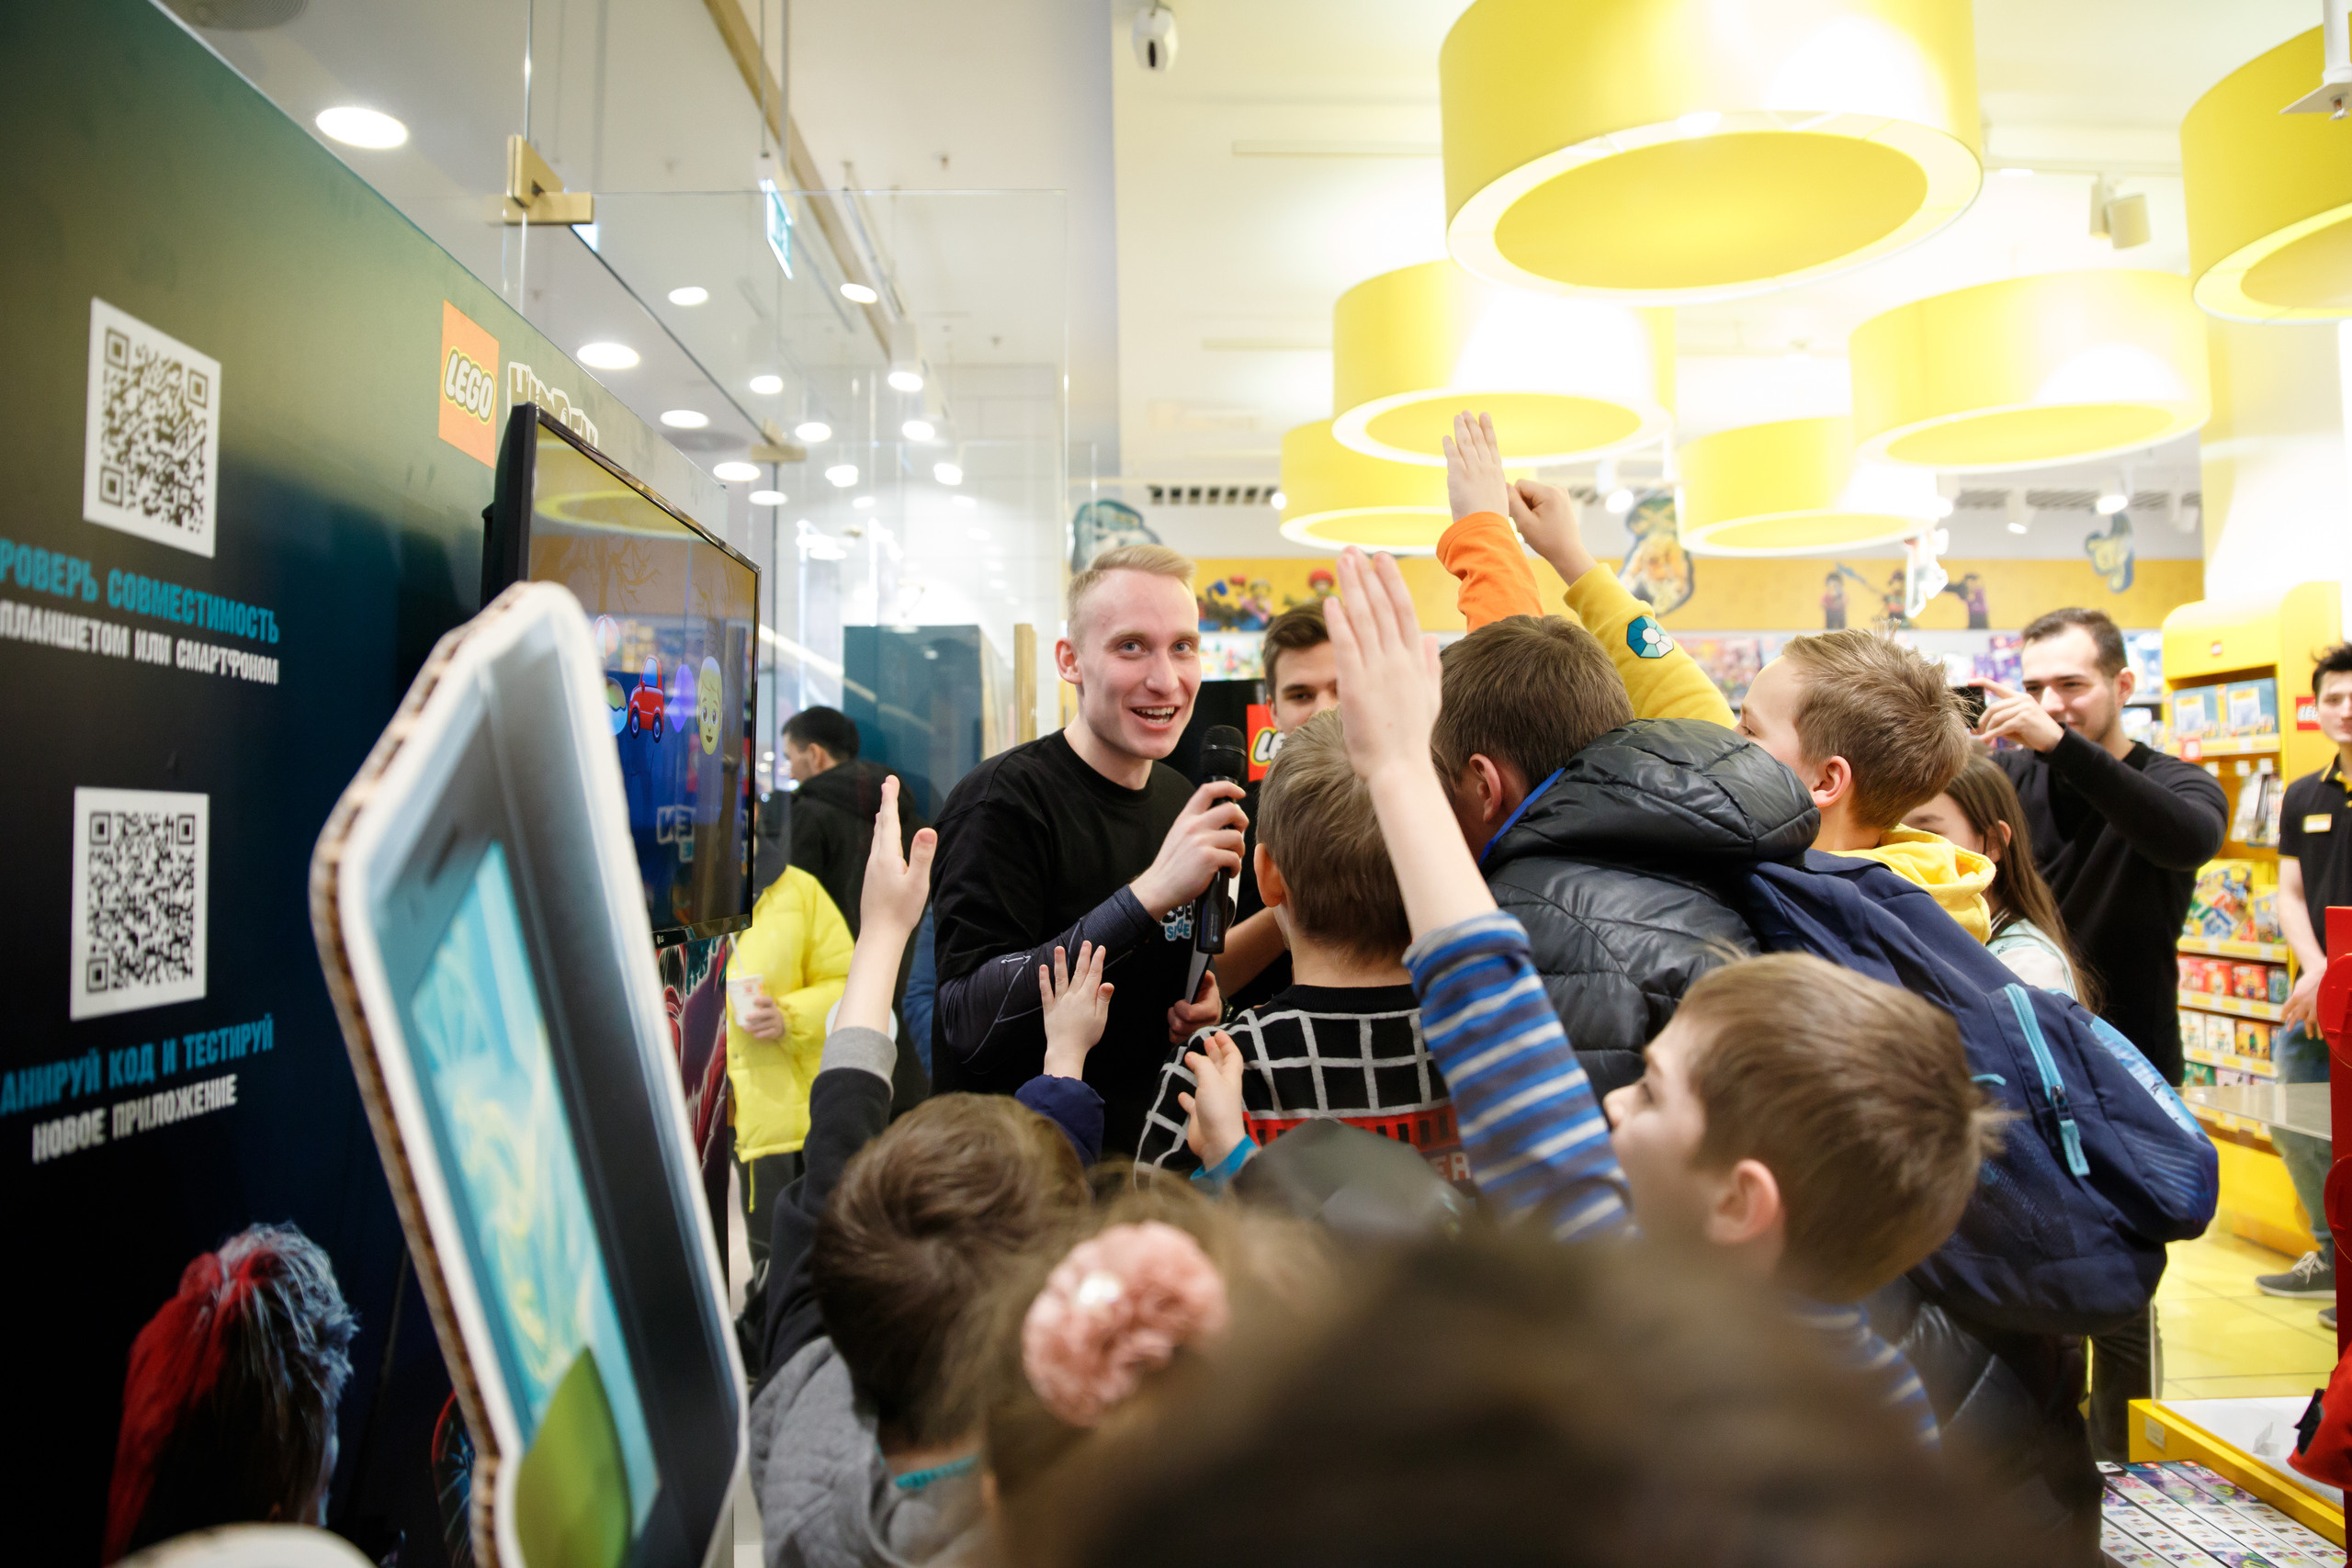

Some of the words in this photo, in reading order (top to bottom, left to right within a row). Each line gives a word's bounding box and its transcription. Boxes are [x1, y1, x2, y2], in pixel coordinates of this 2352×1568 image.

[444, 350, 495, 422] LEGO
[0, 600, 130, 659] ПЛАНШЕТОМ
[134, 628, 173, 667] ИЛИ
[175, 638, 279, 685] СМАРТФОНОМ
[107, 568, 279, 644] СОВМЕСТИМОСТЬ
[1252, 728, 1286, 763] LE
[108, 1043, 155, 1089] КОД
[162, 1038, 177, 1076] И
[183, 1013, 274, 1070] ТЕСТИРУЙ
[32, 1107, 107, 1164] НОВОЕ
[112, 1073, 238, 1140] ПРИЛОЖЕНИЕ
